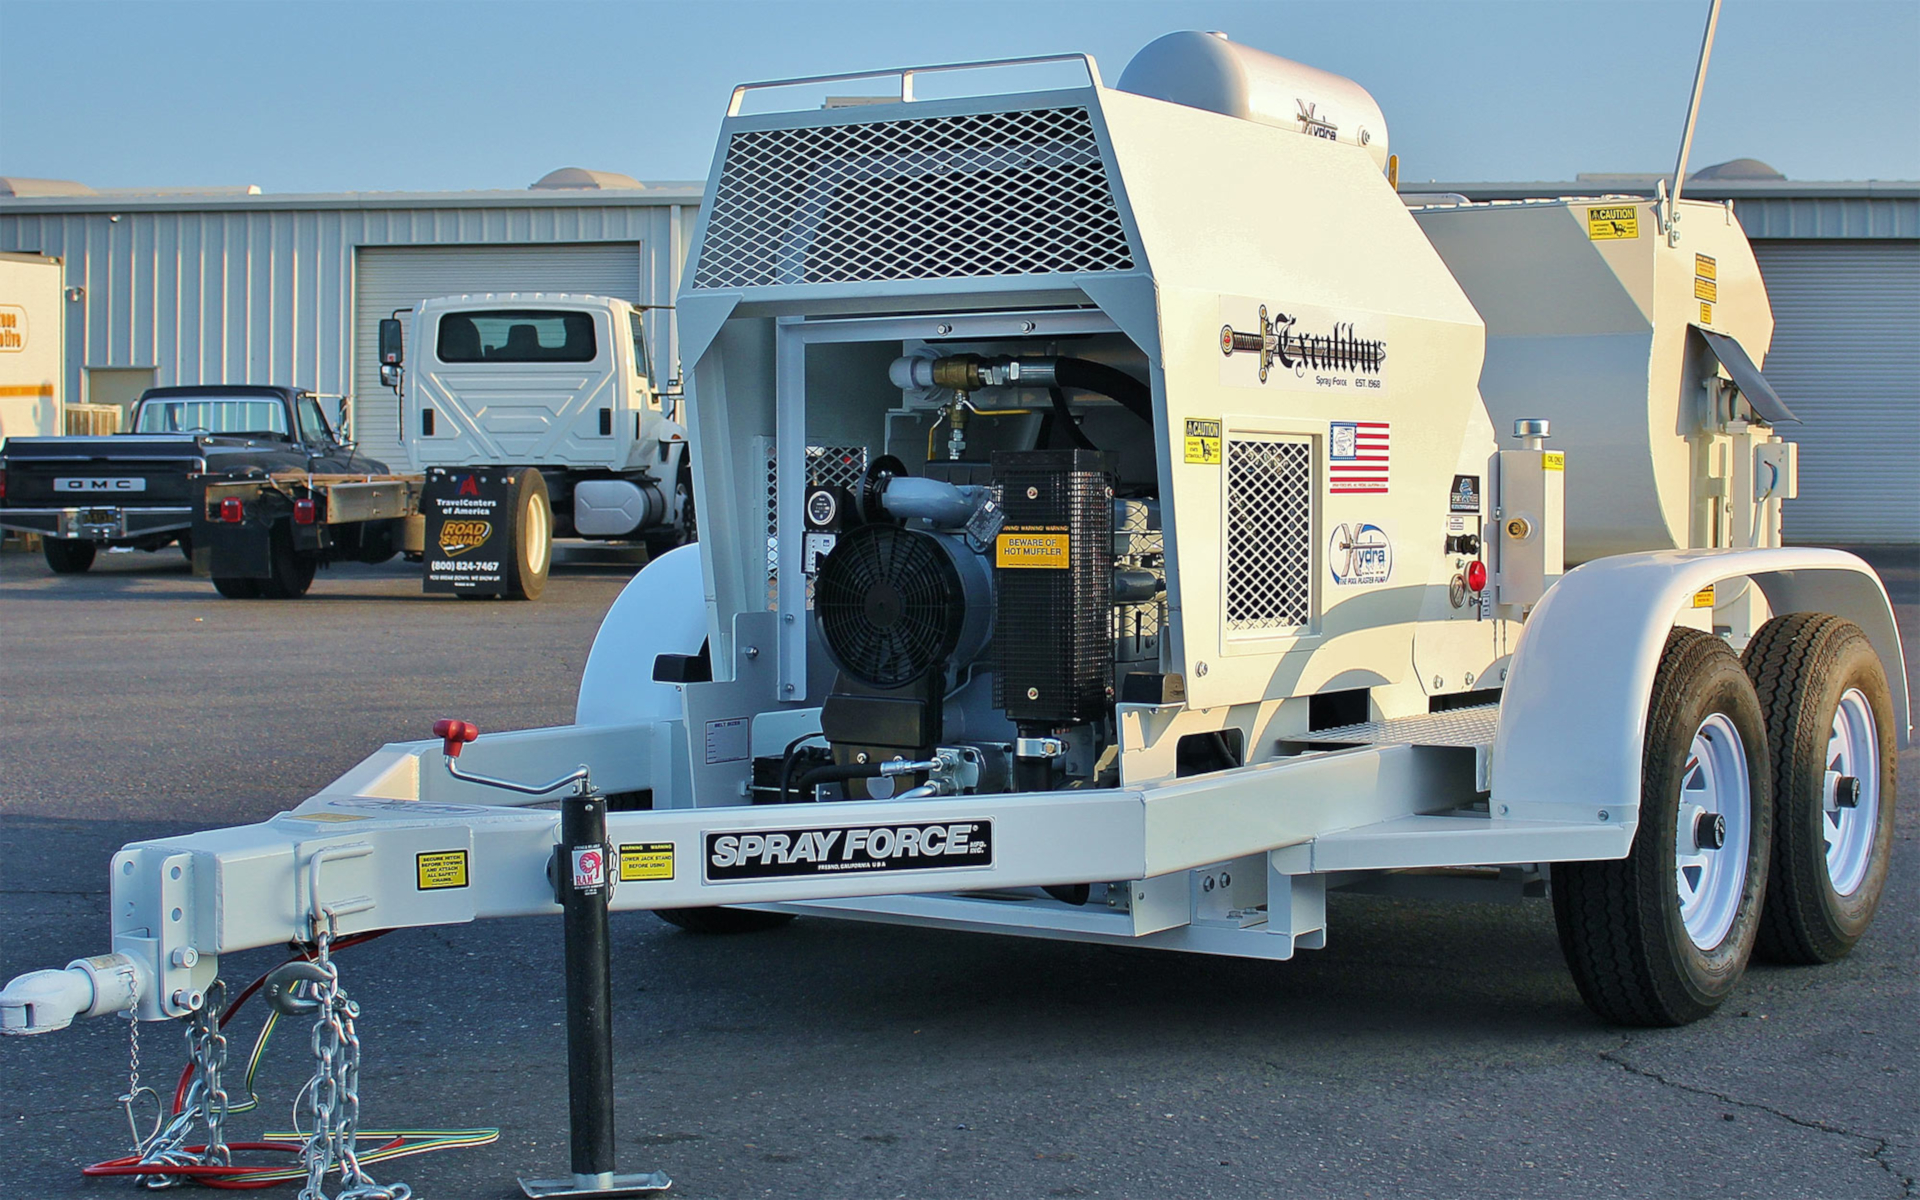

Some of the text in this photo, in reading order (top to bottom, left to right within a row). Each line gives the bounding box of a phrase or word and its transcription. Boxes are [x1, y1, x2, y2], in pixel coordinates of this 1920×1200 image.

[1600, 208, 1634, 220] CAUTION
[1275, 313, 1387, 377] Excalibur
[1316, 376, 1380, 388] Spray Force EST. 1968
[1193, 421, 1219, 437] CAUTION
[68, 481, 131, 489] GMC
[436, 499, 497, 507] TravelCenters
[442, 507, 490, 515] of America
[444, 523, 485, 536] ROAD
[441, 535, 483, 546] SQUAD
[1023, 548, 1061, 556] MUFFLER
[431, 560, 499, 571] (800) 824-7467
[711, 830, 841, 867] SPRAY
[840, 862, 870, 870] CALIFORNIA
[576, 874, 594, 885] RAM
